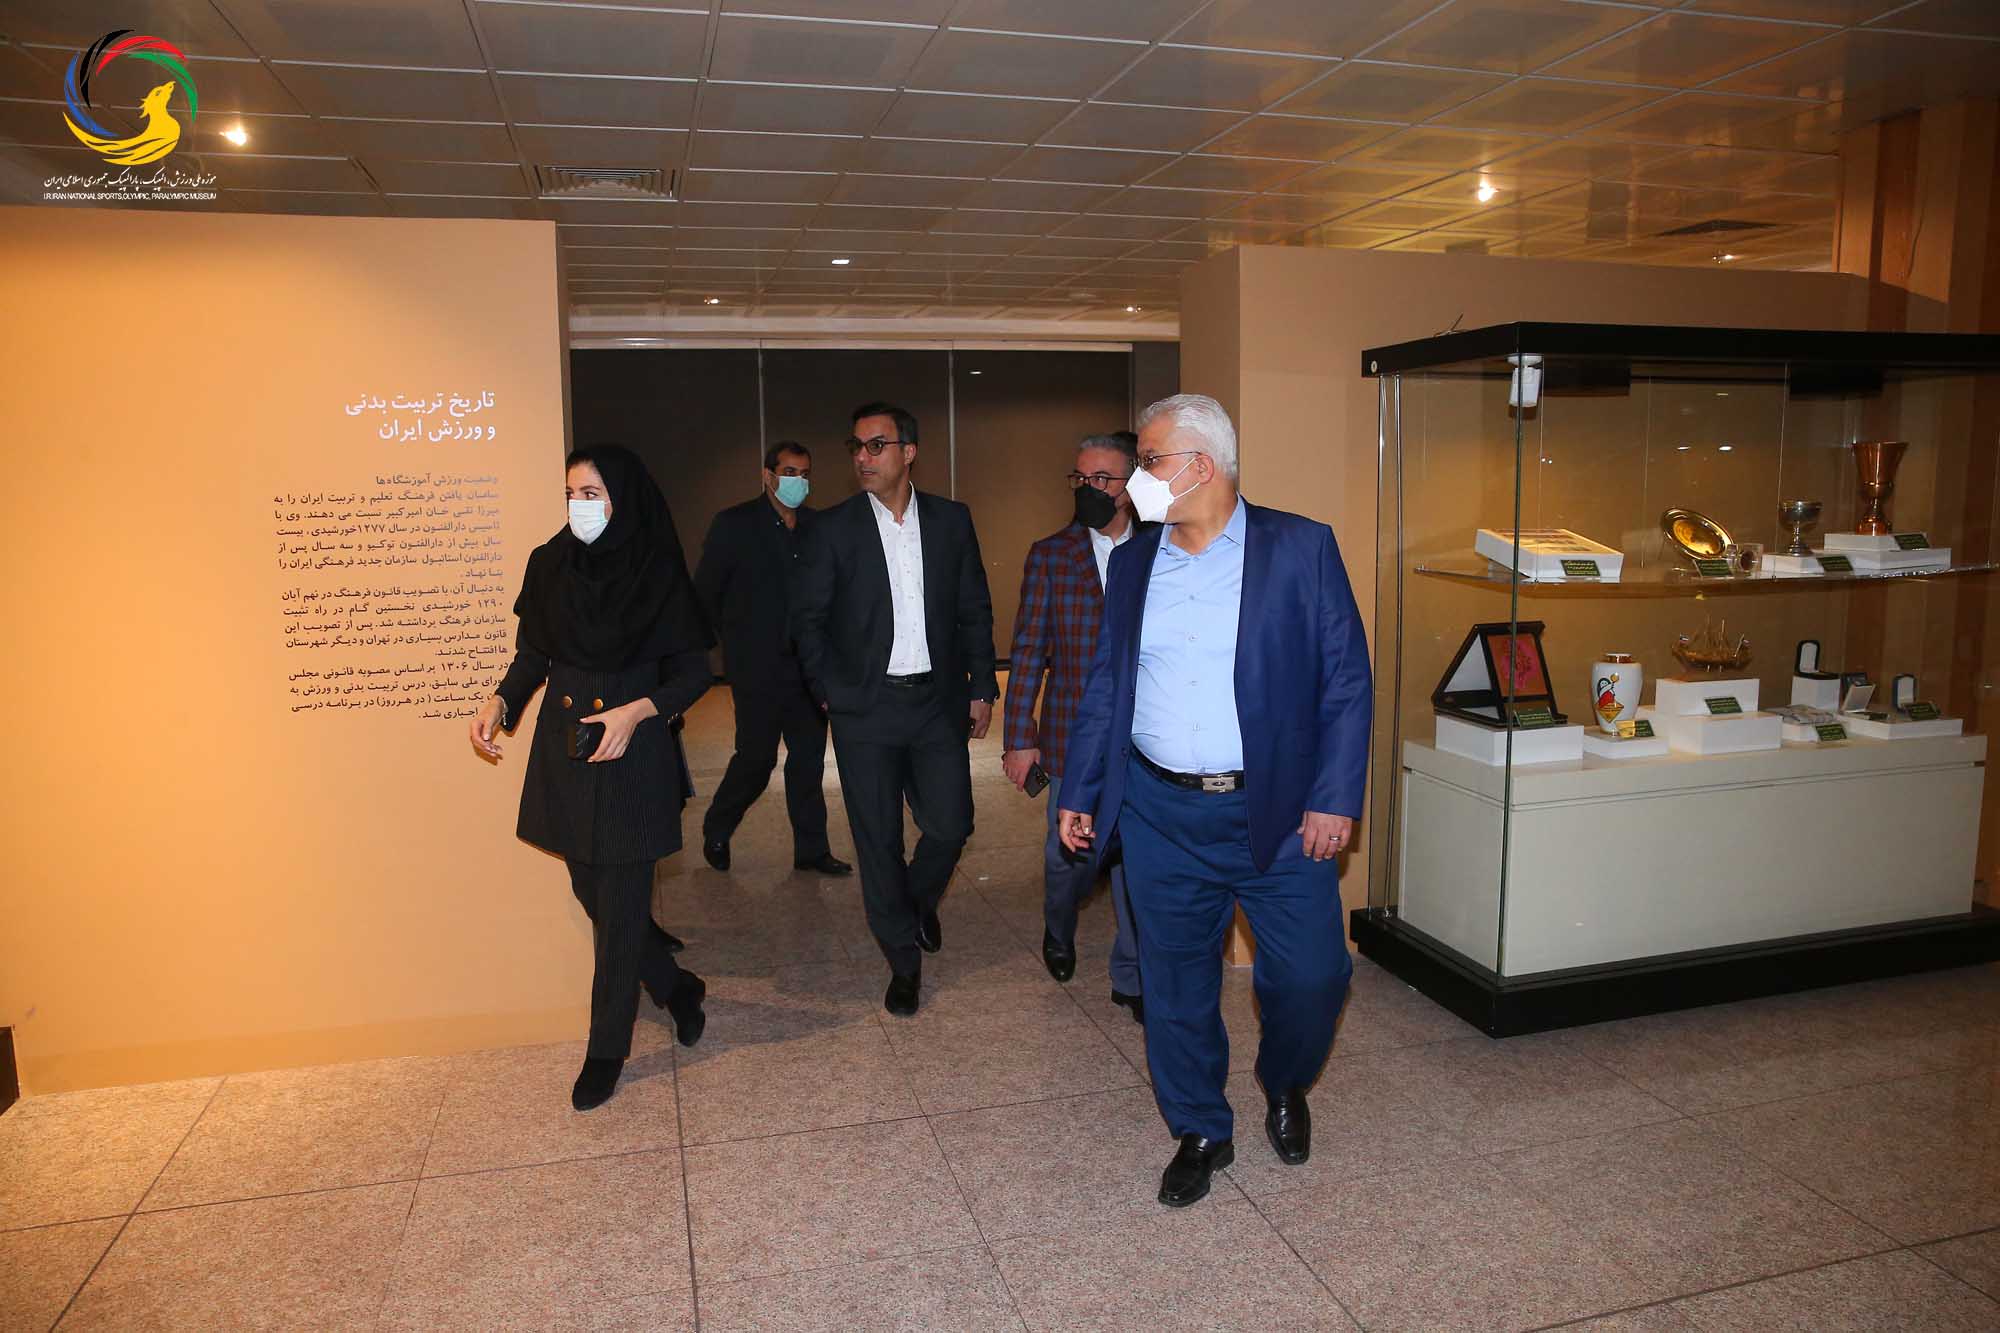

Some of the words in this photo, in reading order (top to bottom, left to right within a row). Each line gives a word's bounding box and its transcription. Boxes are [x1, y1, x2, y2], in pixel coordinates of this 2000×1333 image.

[344, 394, 386, 416] بدنی
[392, 393, 444, 414] تربیت
[449, 390, 495, 416] تاریخ
[379, 418, 422, 442] ایران
[428, 420, 482, 442] ورزش
[487, 425, 496, 440] و
[274, 496, 283, 505] به
[287, 494, 296, 504] را
[300, 493, 323, 504] ایران
[328, 494, 356, 504] تربیت
[370, 492, 392, 506] تعلیم
[398, 490, 434, 502] فرهنگ
[275, 510, 282, 522] با
[286, 512, 300, 520] وی
[356, 508, 381, 519] نسبت
[276, 528, 304, 537] بیست
[388, 524, 407, 533] سال
[423, 521, 466, 533] دارالفنون
[278, 542, 286, 553] از
[312, 540, 335, 551] سال
[400, 538, 443, 550] دارالفنون
[448, 538, 456, 548] از
[290, 546, 308, 554] پس
[279, 559, 287, 569] را
[290, 558, 312, 569] ایران
[314, 556, 354, 570] فرهنگی
[357, 558, 382, 567] جدید
[384, 556, 416, 565] سازمان
[334, 587, 371, 599] فرهنگ
[373, 586, 400, 598] قانون
[403, 586, 439, 597] تصویب
[442, 585, 448, 594] با
[467, 583, 493, 594] دنبال
[496, 584, 504, 594] به
[282, 588, 300, 601] آبان
[304, 590, 319, 603] نهم
[322, 590, 332, 599] در
[315, 604, 327, 615] راه
[333, 606, 343, 616] در
[349, 602, 369, 616] گام
[376, 603, 415, 614] نخستین
[422, 601, 471, 612] خورشیدی
[345, 620, 352, 630] از
[397, 617, 436, 628] برداشته
[440, 615, 471, 626] فرهنگ
[474, 615, 506, 624] سازمان
[285, 622, 300, 634] این
[303, 620, 341, 634] تصویب
[356, 623, 373, 631] پس
[366, 634, 390, 645] تهران
[406, 632, 442, 644] بسیاری
[444, 631, 480, 642] مدارس
[484, 629, 507, 640] قانون
[286, 638, 328, 648] شهرستان
[330, 635, 357, 648] دیگر
[393, 636, 403, 645] در
[468, 645, 497, 658] افتتاح
[498, 646, 508, 654] ها
[442, 662, 468, 671] ۱۳۰۶
[472, 661, 495, 670] سال
[498, 662, 508, 670] در
[288, 669, 319, 681] مجلس
[323, 667, 354, 679] قانونی
[358, 668, 390, 677] مصوبه
[367, 681, 399, 692] تربیت
[402, 682, 426, 691] درس
[462, 677, 478, 688] ملی
[290, 688, 299, 696] به
[303, 684, 331, 696] ورزش
[343, 684, 364, 694] بدنی
[434, 693, 466, 702] ساعت
[468, 692, 484, 702] یک
[291, 701, 323, 712] درسی
[326, 698, 361, 709] برنامه
[364, 699, 374, 707] در
[444, 707, 478, 718] اجباری
